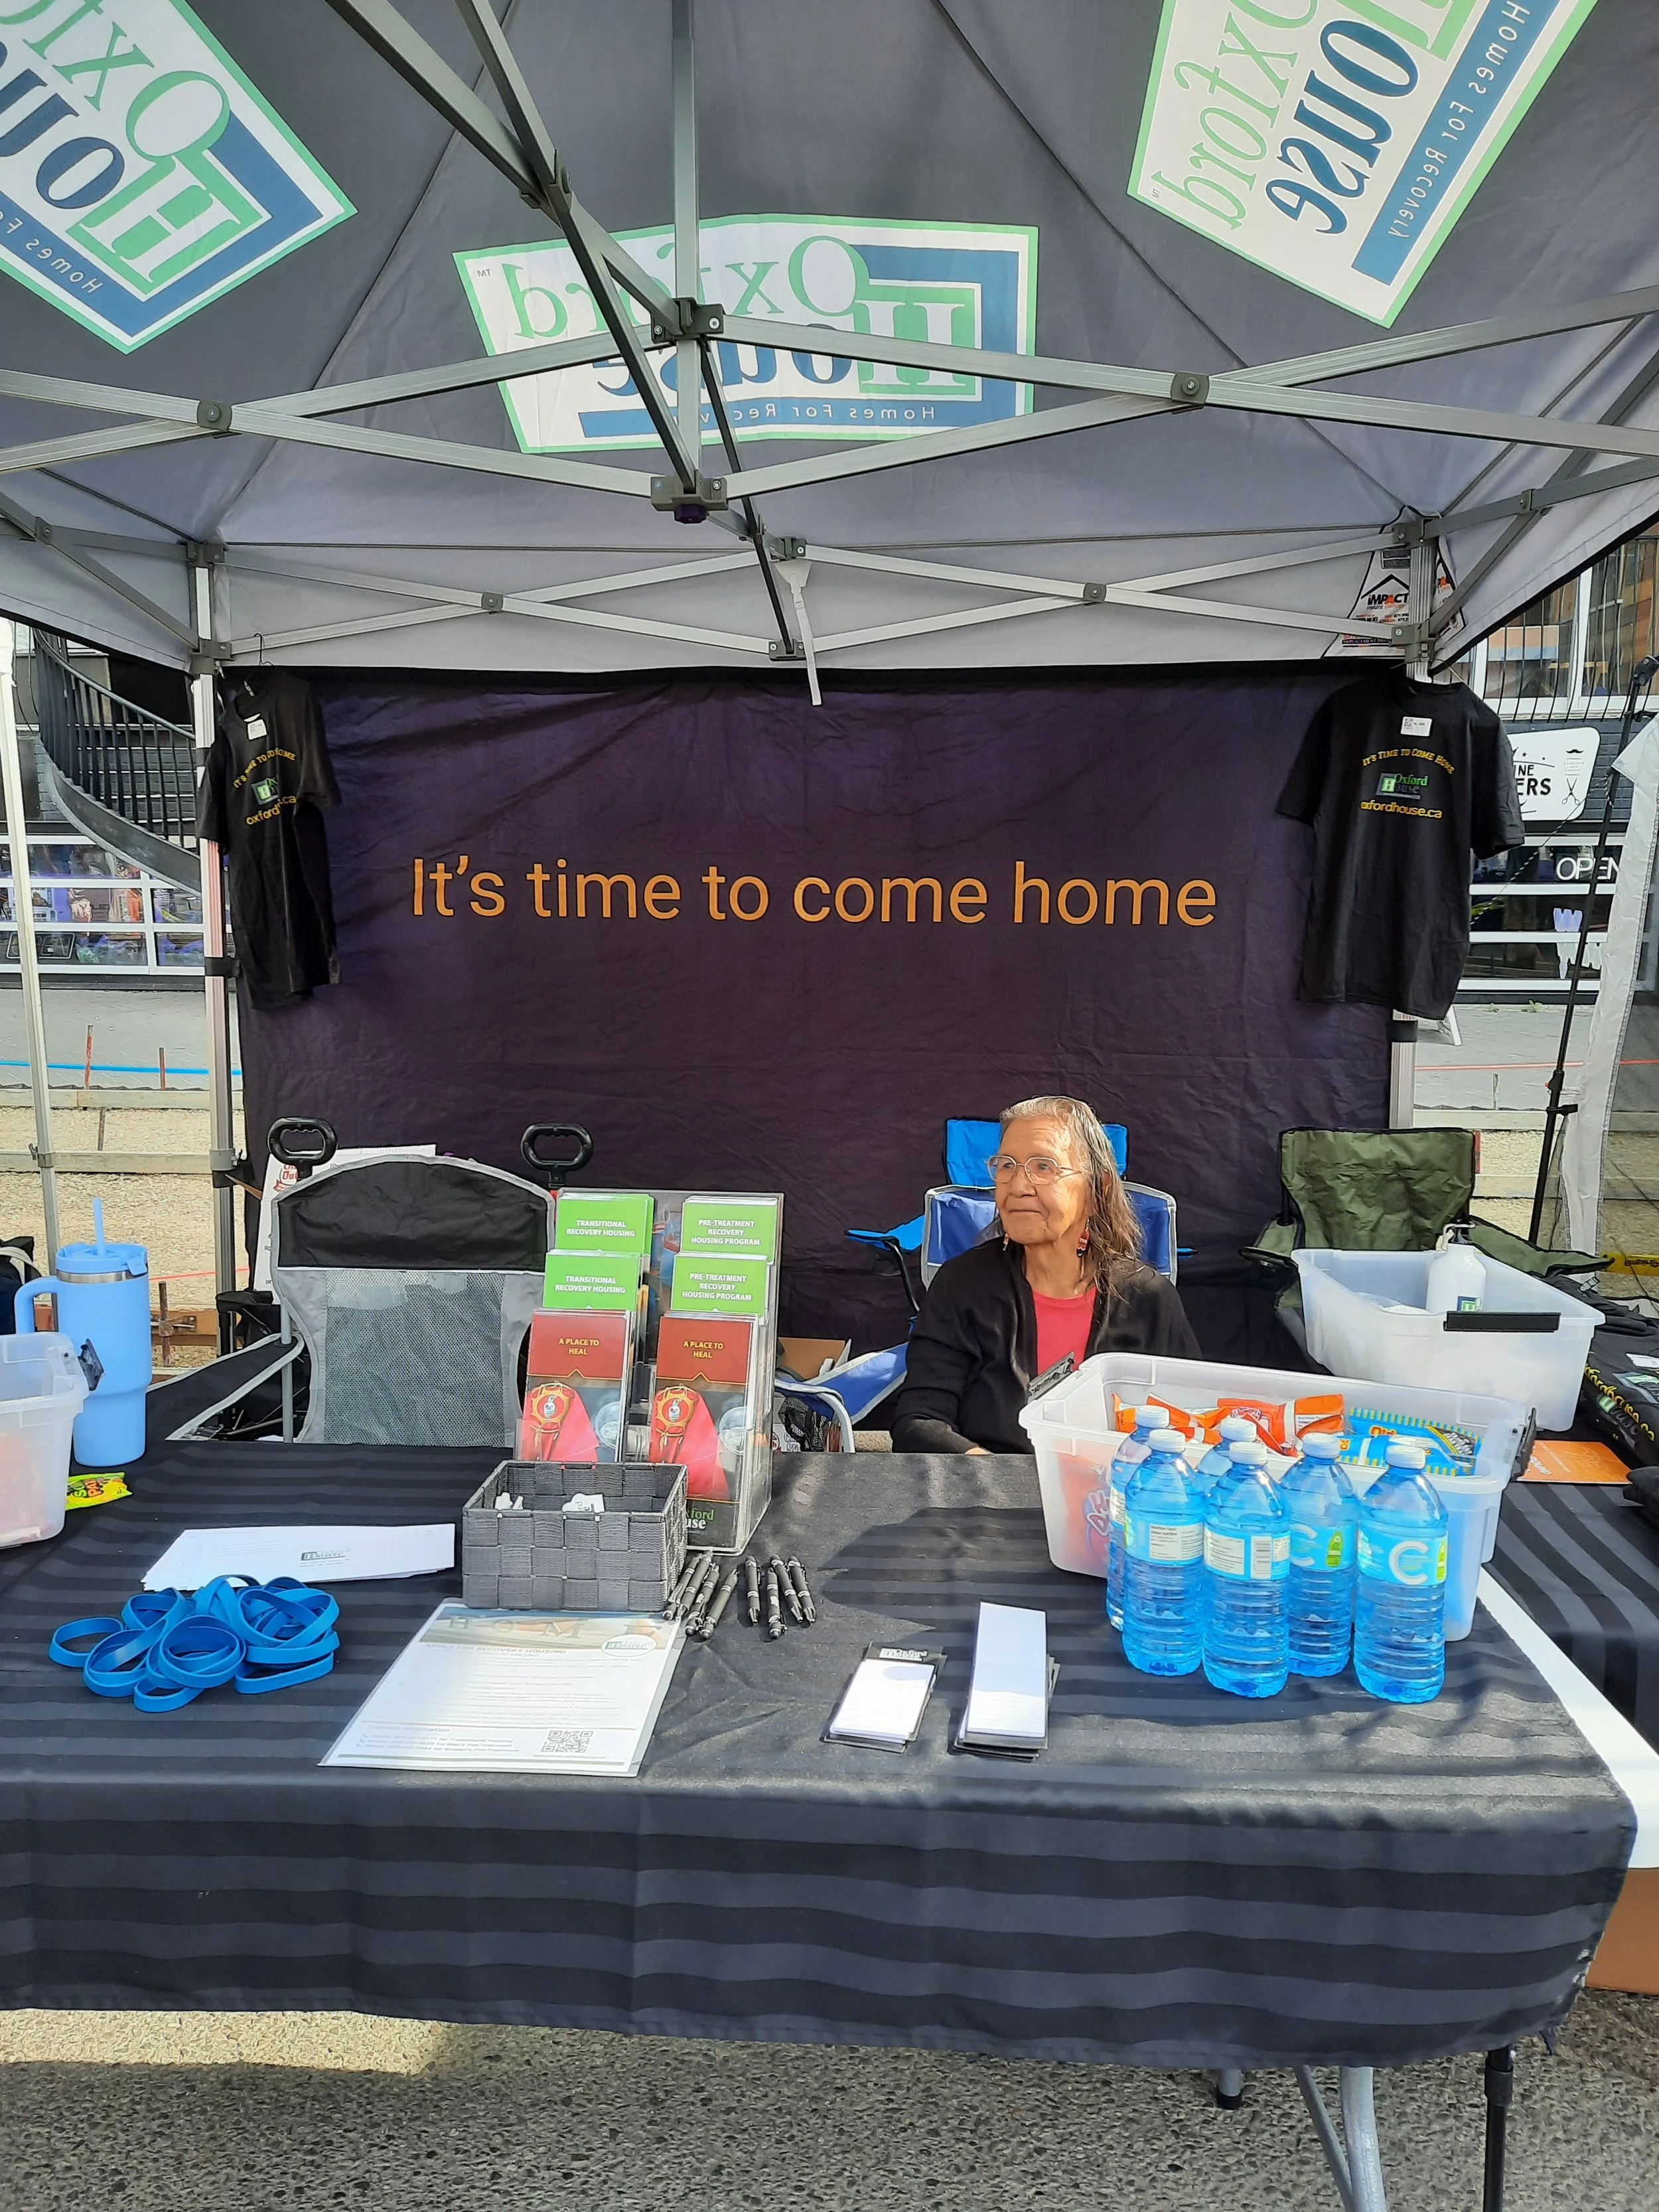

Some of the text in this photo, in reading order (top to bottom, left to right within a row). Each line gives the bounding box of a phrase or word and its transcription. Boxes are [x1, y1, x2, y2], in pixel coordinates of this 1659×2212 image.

[1378, 749, 1399, 759] TIME
[1411, 749, 1435, 761] COME
[1394, 773, 1429, 786] Oxford
[413, 855, 1216, 926] It's time to come home
[565, 1276, 617, 1284] TRANSITIONAL
[689, 1273, 747, 1282] PRE-TREATMENT
[699, 1282, 735, 1291] RECOVERY
[715, 1292, 752, 1301] PROGRAM
[693, 1351, 713, 1359] HEAL
[685, 1518, 707, 1530] use
[1389, 1540, 1429, 1585] C
